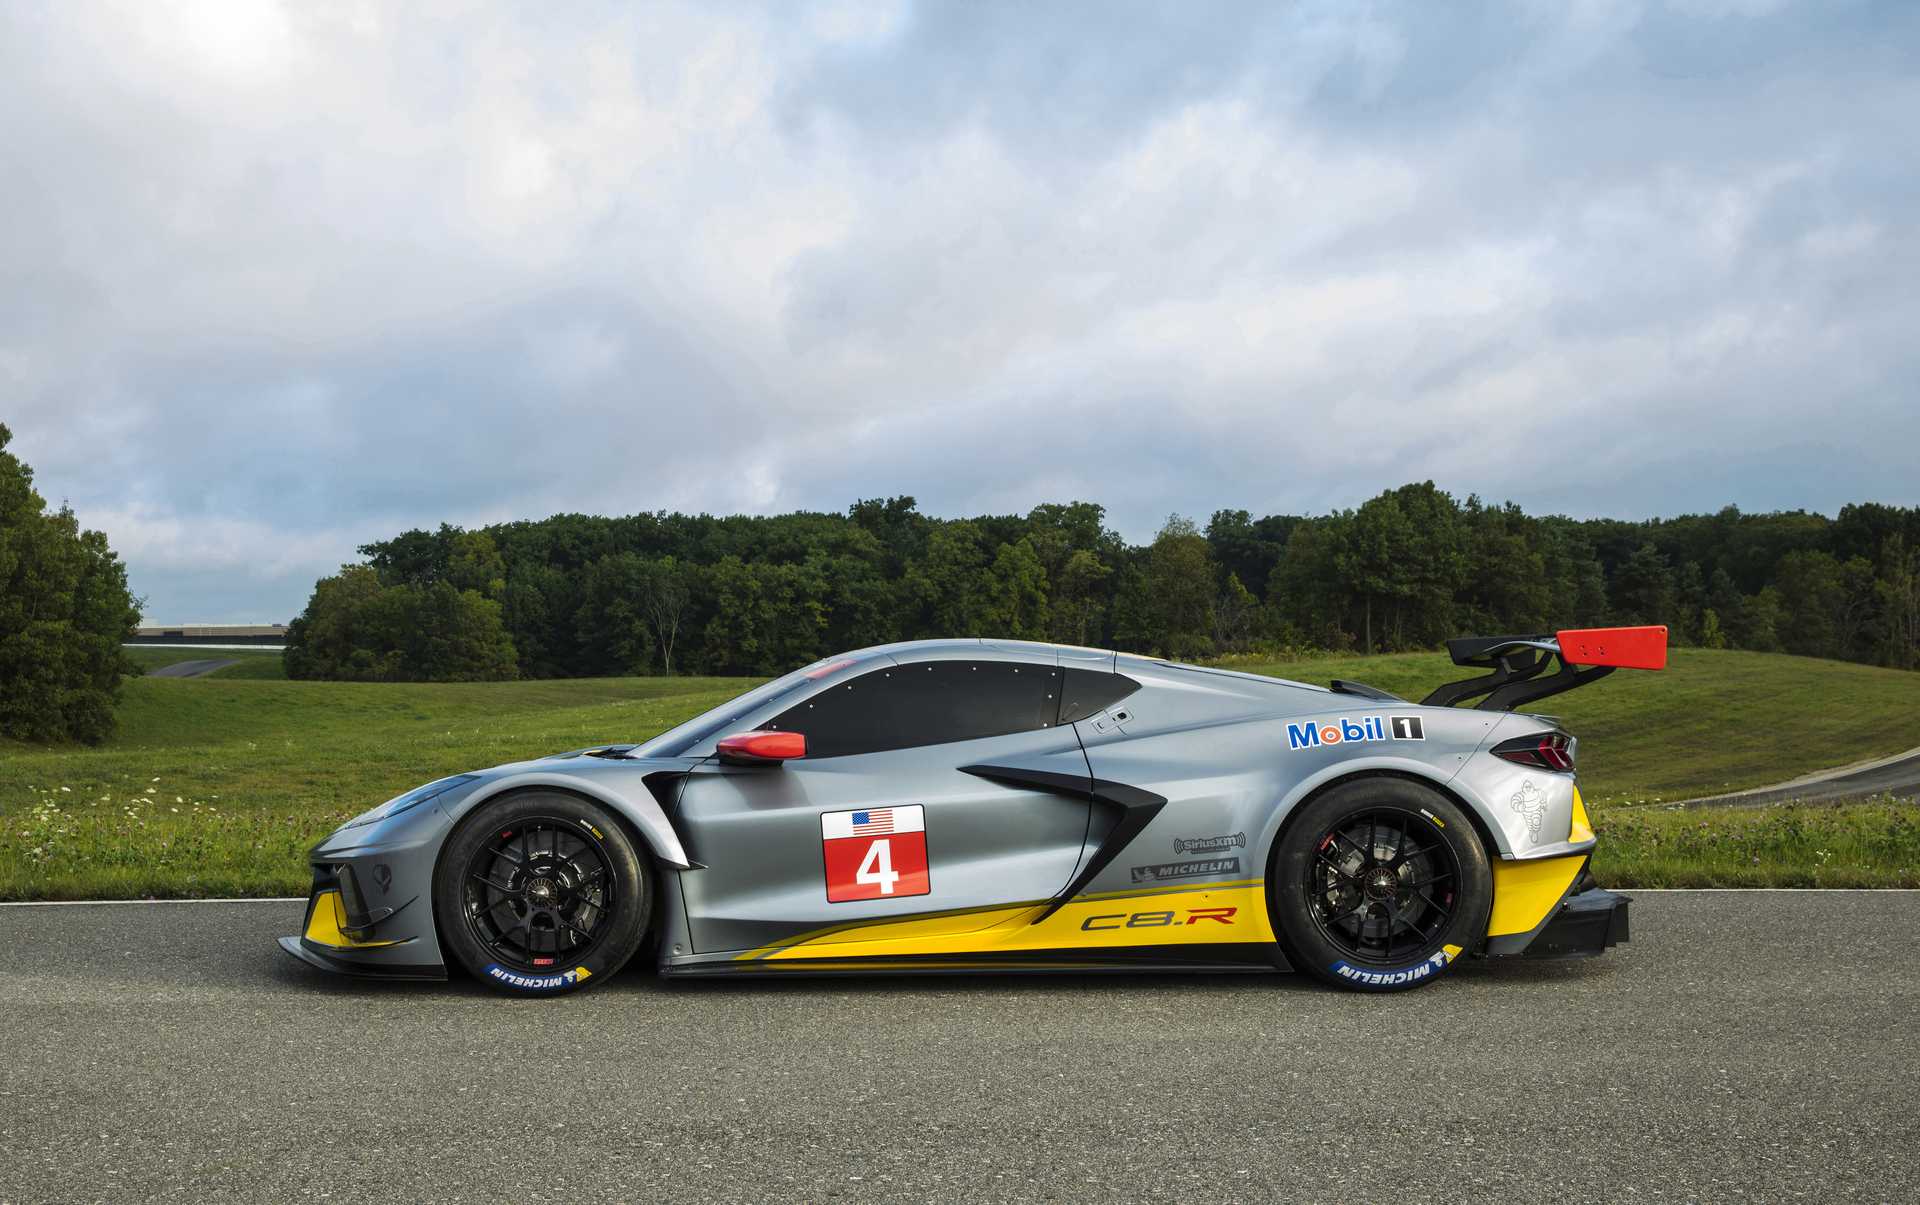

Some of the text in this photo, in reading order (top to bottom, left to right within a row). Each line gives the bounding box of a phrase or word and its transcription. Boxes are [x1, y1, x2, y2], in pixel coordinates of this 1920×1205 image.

[1287, 716, 1384, 749] Mobil
[856, 839, 899, 894] 4
[1159, 861, 1234, 877] MICHELIN
[1081, 907, 1238, 931] C8.R
[490, 967, 563, 988] MICHELIN
[1336, 963, 1431, 985] MICHELIN
